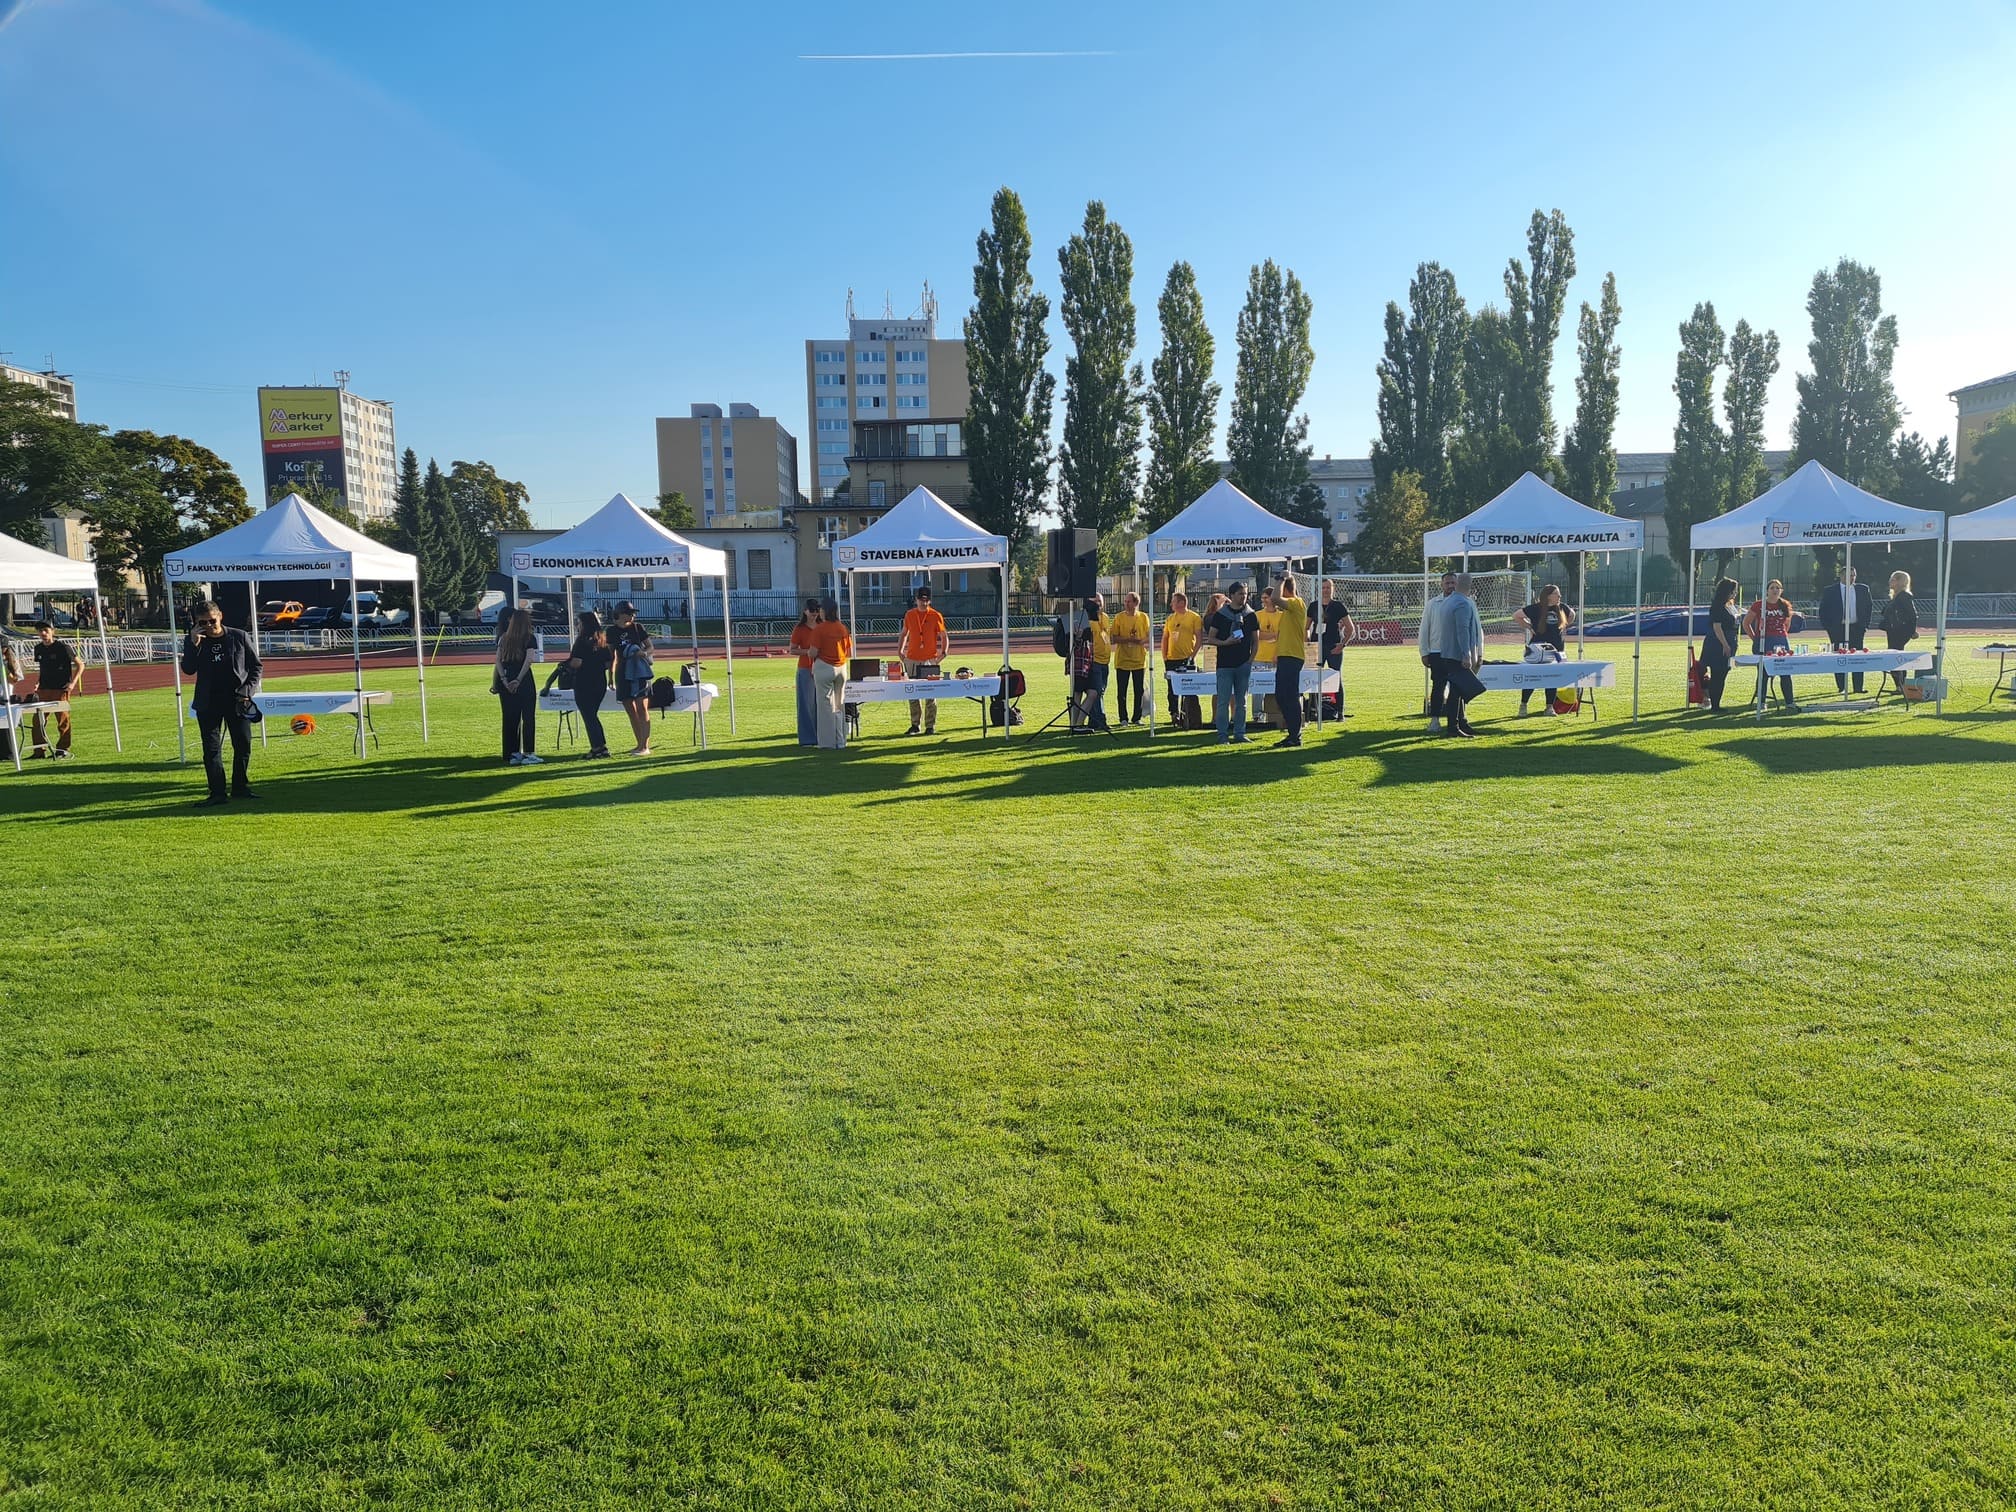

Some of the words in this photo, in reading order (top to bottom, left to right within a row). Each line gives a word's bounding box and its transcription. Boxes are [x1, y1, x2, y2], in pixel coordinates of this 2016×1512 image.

[269, 408, 333, 422] Merkury
[270, 421, 324, 433] Market
[1488, 533, 1564, 544] STROJNÍCKA
[1567, 532, 1620, 543] FAKULTA
[1803, 530, 1851, 538] METALURGIE
[1217, 537, 1288, 545] ELEKTROTECHNIKY
[860, 547, 923, 560] STAVEBNÁ
[926, 547, 980, 559] FAKULTA
[187, 564, 224, 572] FAKULTA
[225, 563, 275, 572] VÝROBNÝCH
[532, 556, 613, 568] EKONOMICKÁ
[616, 557, 670, 567] FAKULTA
